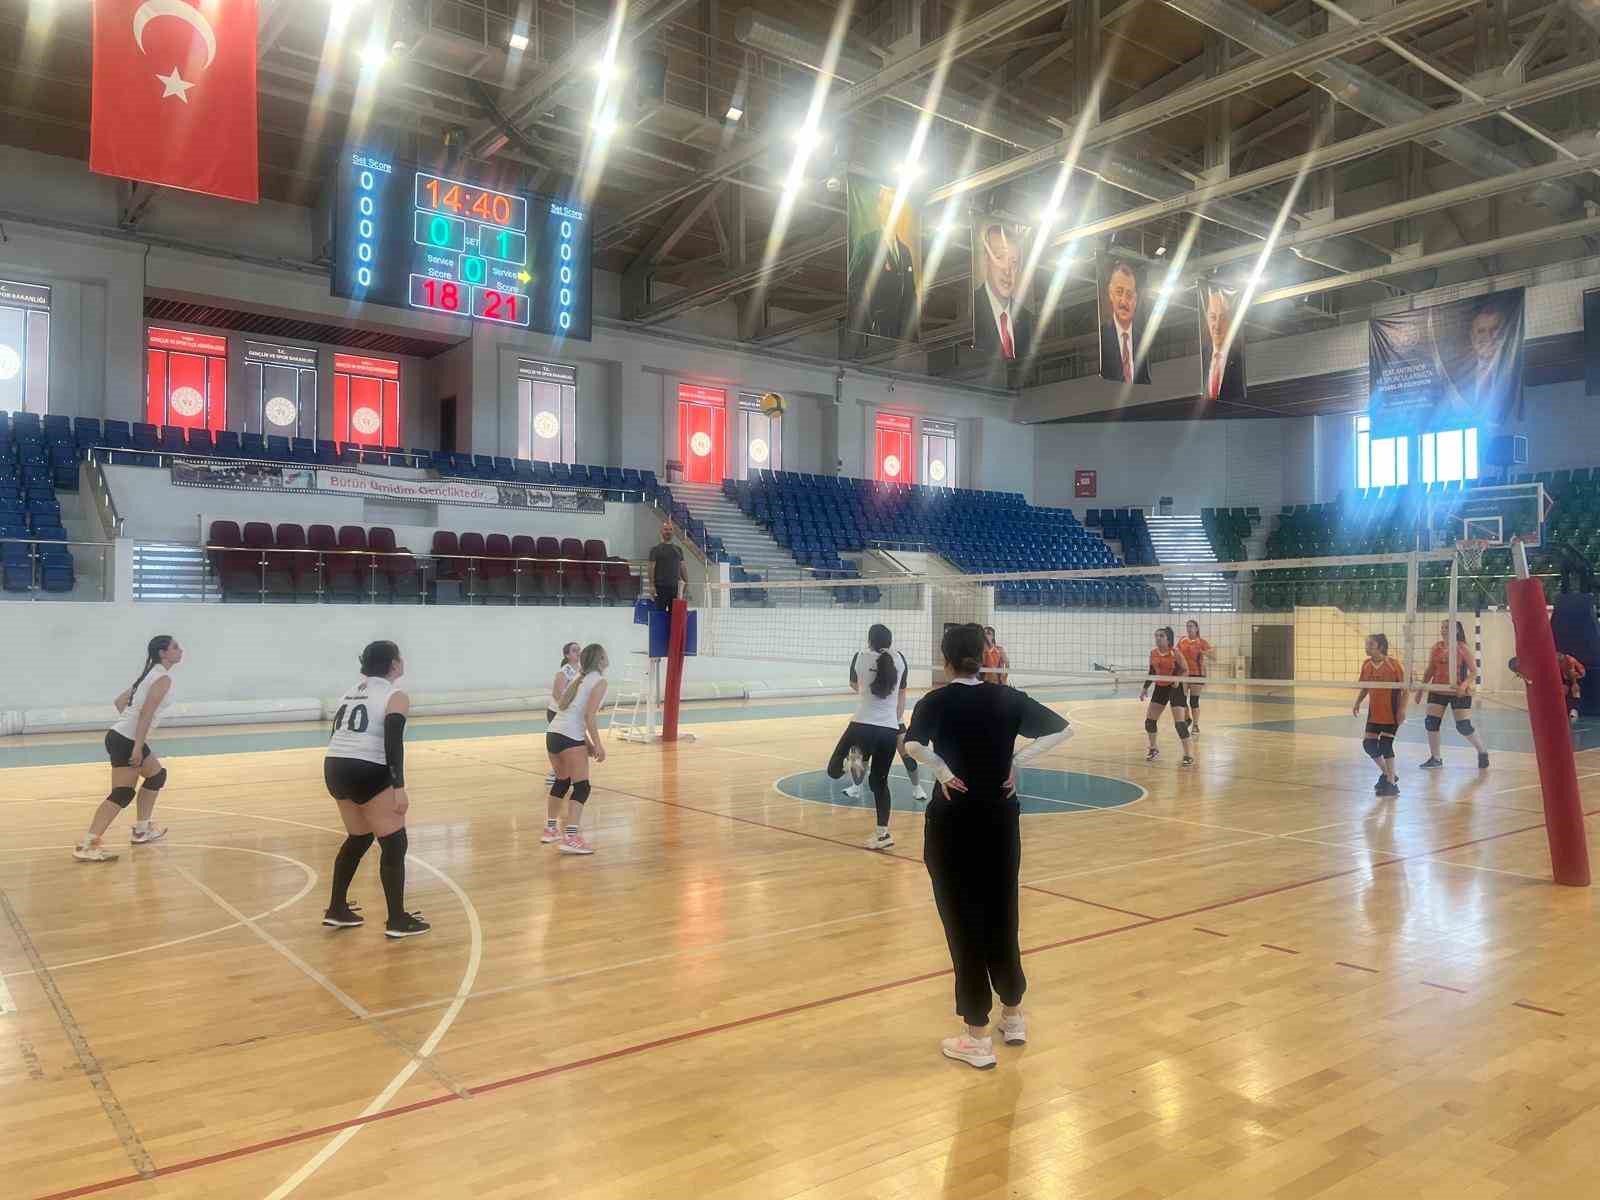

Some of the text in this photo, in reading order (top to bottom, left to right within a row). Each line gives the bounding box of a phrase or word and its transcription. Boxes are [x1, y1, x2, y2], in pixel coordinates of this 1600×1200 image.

[368, 158, 392, 173] Score
[361, 172, 373, 190] 0
[360, 197, 373, 215] 0
[425, 179, 511, 225] 14:40
[360, 220, 372, 238] 0
[429, 216, 449, 246] 0
[561, 221, 571, 239] 0
[465, 237, 480, 246] SET
[496, 231, 508, 259] 1
[359, 243, 371, 261] 0
[427, 254, 454, 267] Service
[561, 243, 571, 261] 0
[358, 267, 371, 286] 0
[427, 267, 453, 280] Score
[464, 257, 482, 282] 0
[560, 267, 571, 284] 0
[423, 279, 459, 311] 18
[496, 281, 521, 293] Score
[483, 291, 517, 321] 21
[560, 289, 571, 306] 0
[560, 312, 571, 329] 0
[336, 703, 369, 733] 10
